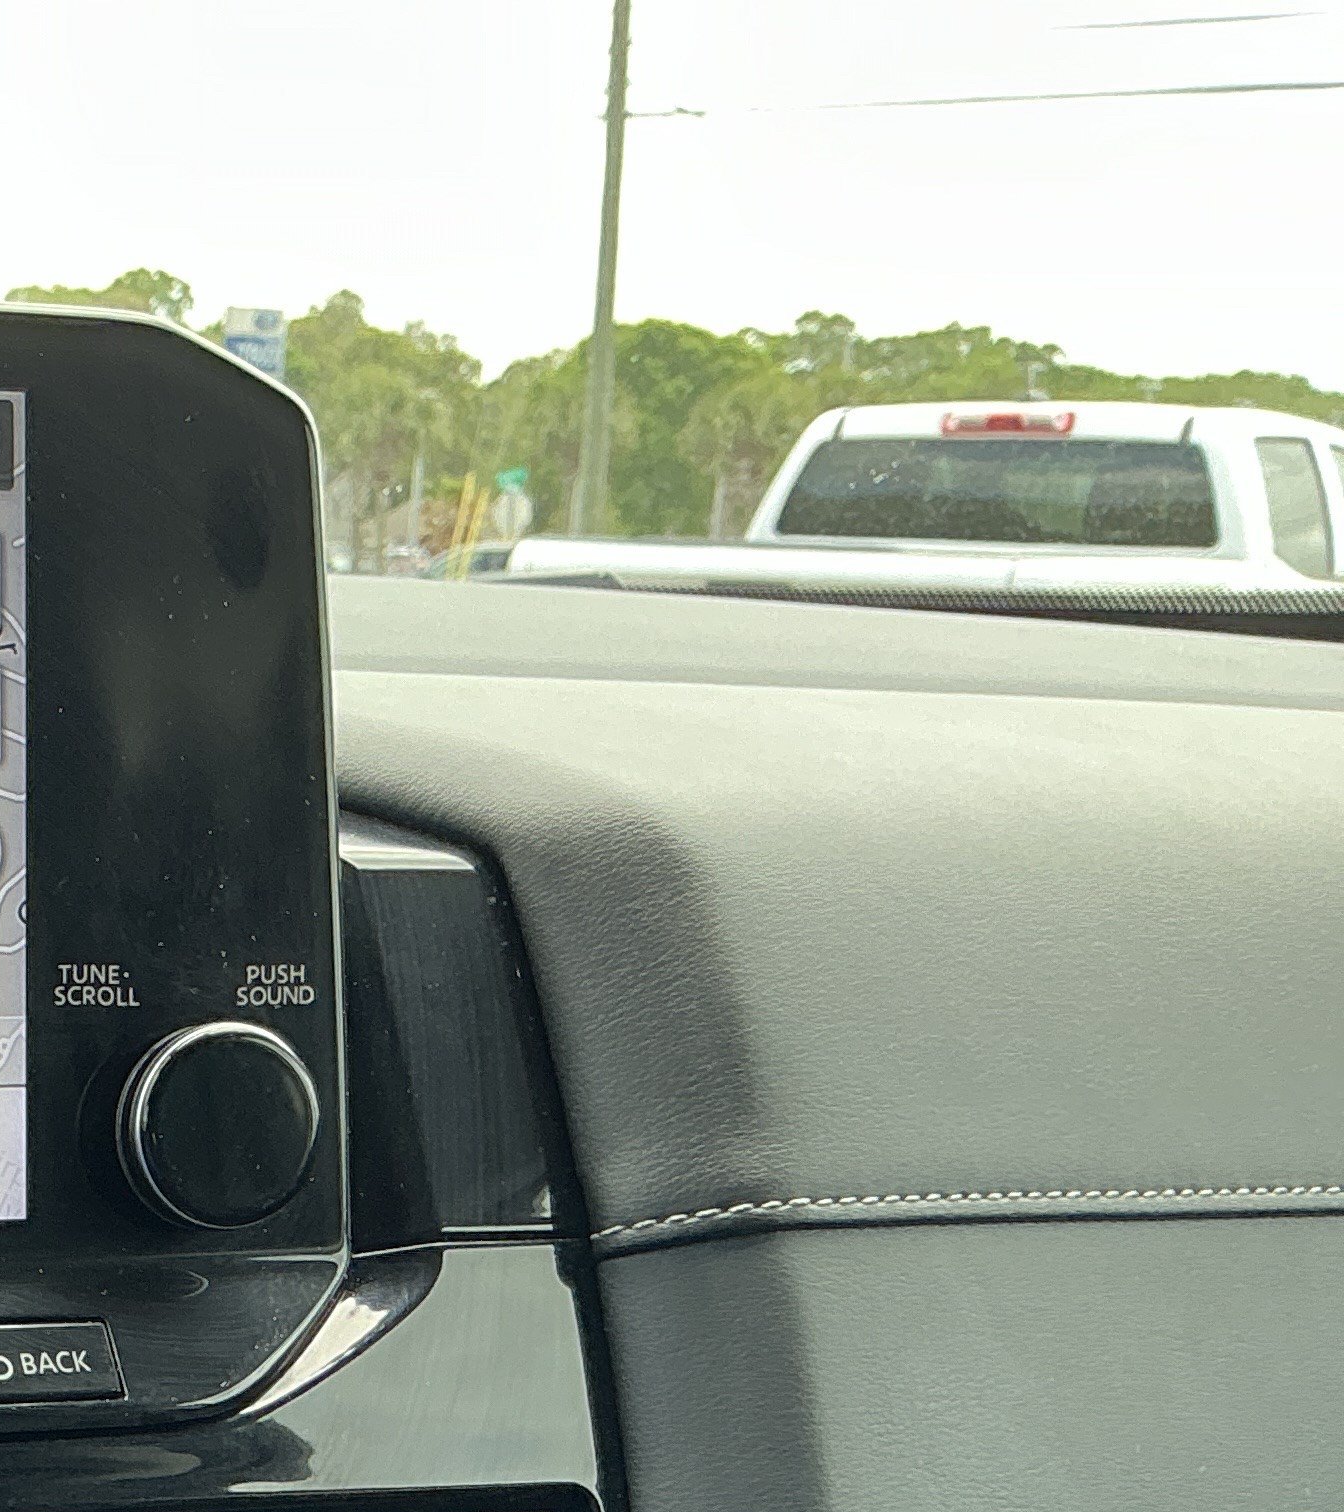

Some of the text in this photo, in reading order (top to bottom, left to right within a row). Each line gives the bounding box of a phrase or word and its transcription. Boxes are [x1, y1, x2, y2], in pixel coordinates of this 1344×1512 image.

[245, 963, 306, 985] PUSH
[53, 985, 141, 1008] SCROLL
[235, 985, 316, 1007] SOUND
[19, 1349, 92, 1376] BACK
